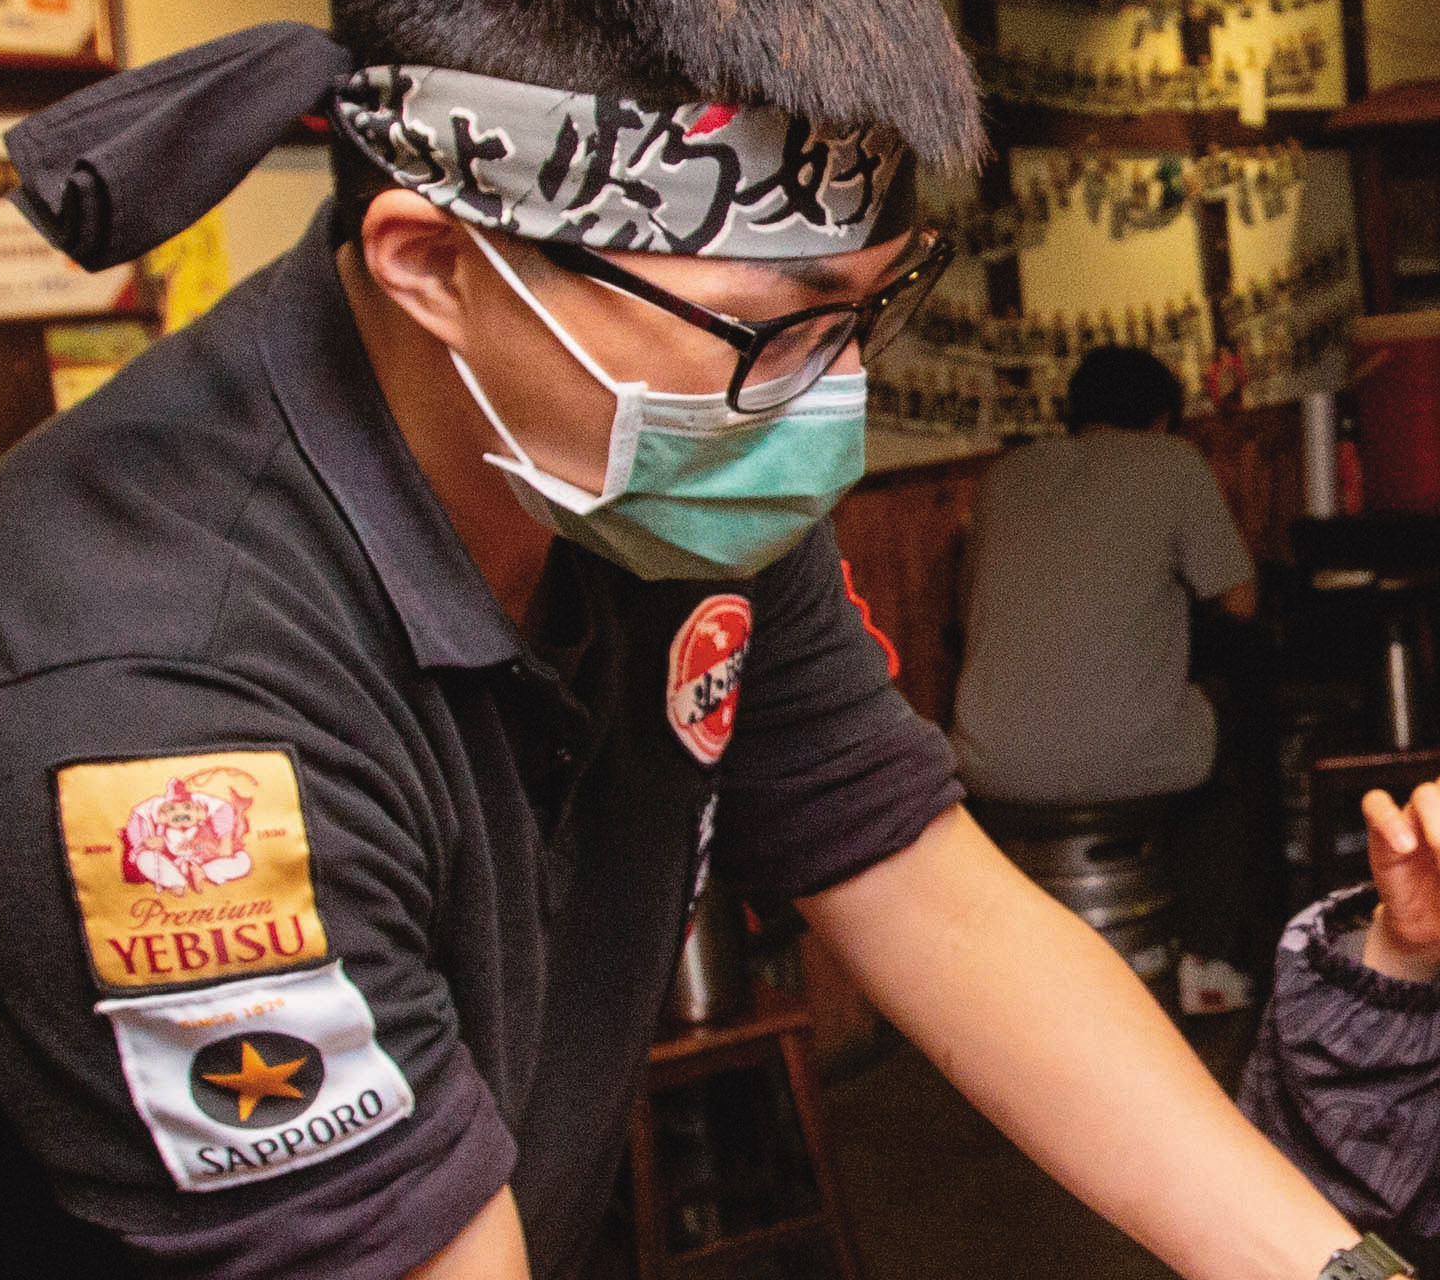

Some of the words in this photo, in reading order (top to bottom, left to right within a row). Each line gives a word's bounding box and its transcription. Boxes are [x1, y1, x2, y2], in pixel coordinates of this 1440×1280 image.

[130, 897, 274, 929] Premium
[107, 915, 304, 975] YEBISU
[197, 1089, 383, 1174] SAPPORO
